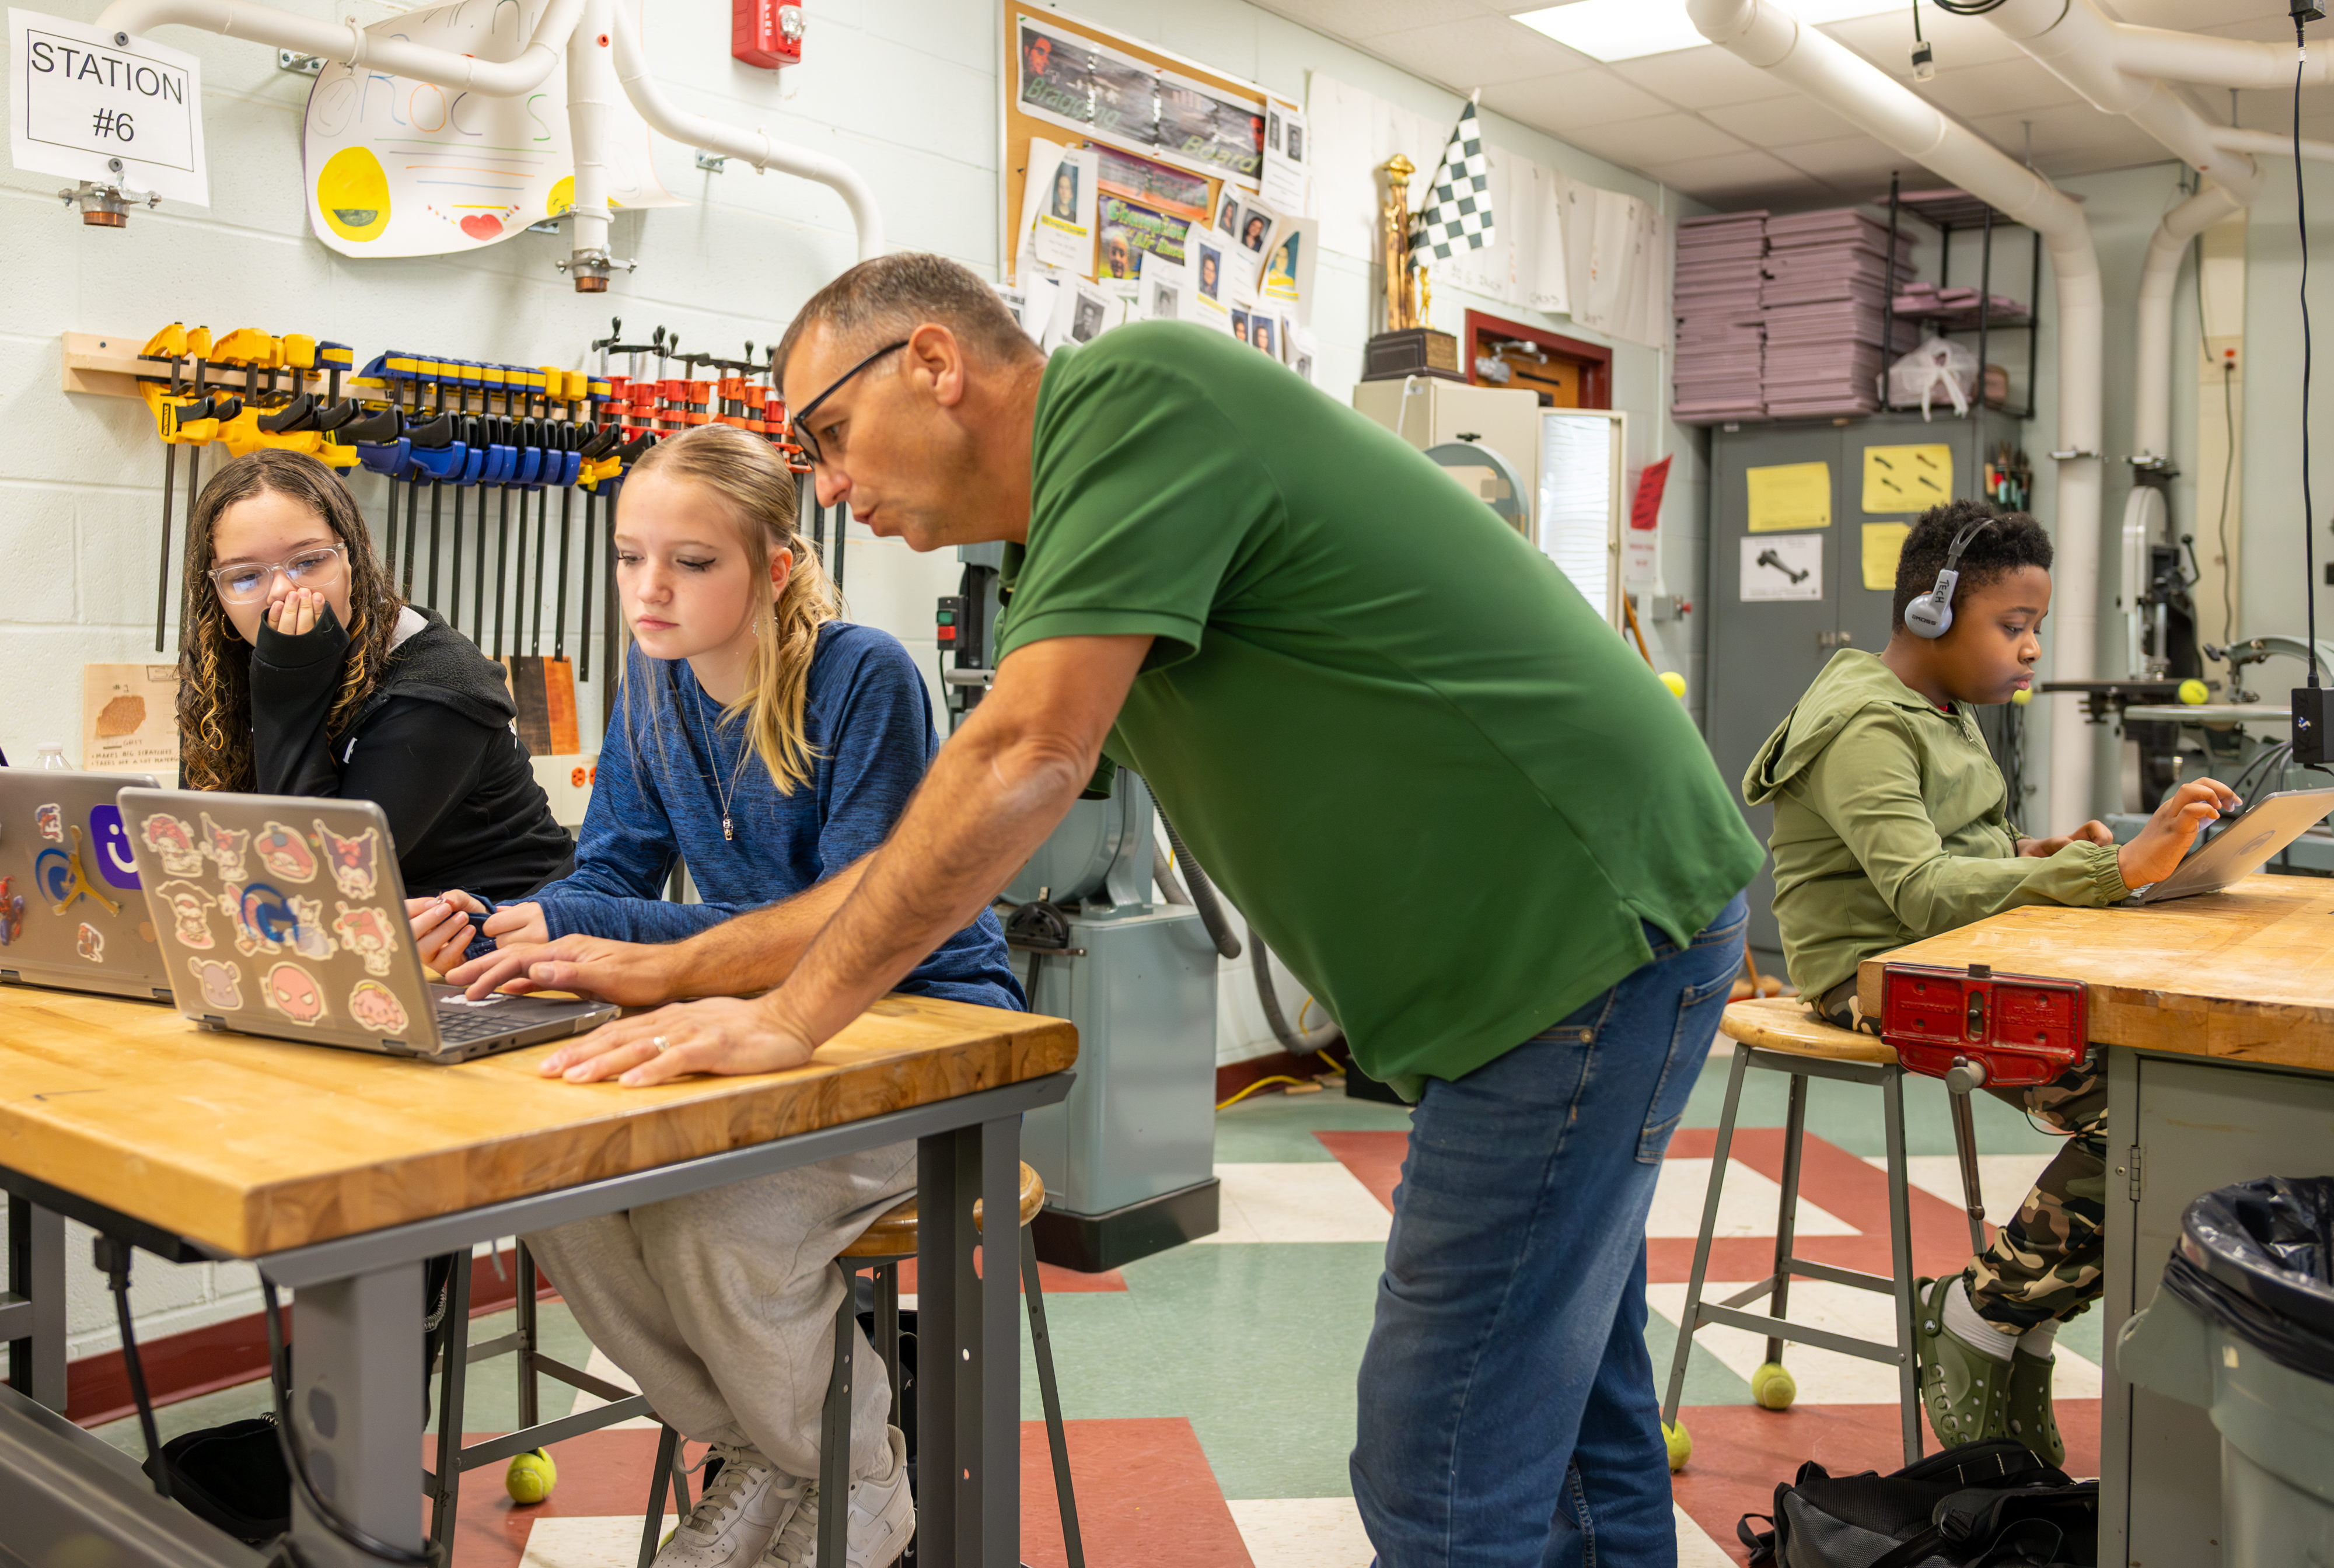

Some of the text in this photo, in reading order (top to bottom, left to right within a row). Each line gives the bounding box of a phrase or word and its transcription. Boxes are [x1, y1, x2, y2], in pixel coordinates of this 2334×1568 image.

[764, 4, 772, 36] FIRE
[32, 41, 181, 104] STATION
[93, 107, 134, 142] #6
[1181, 135, 1262, 173] Board
[1935, 579, 1949, 603] TECH
